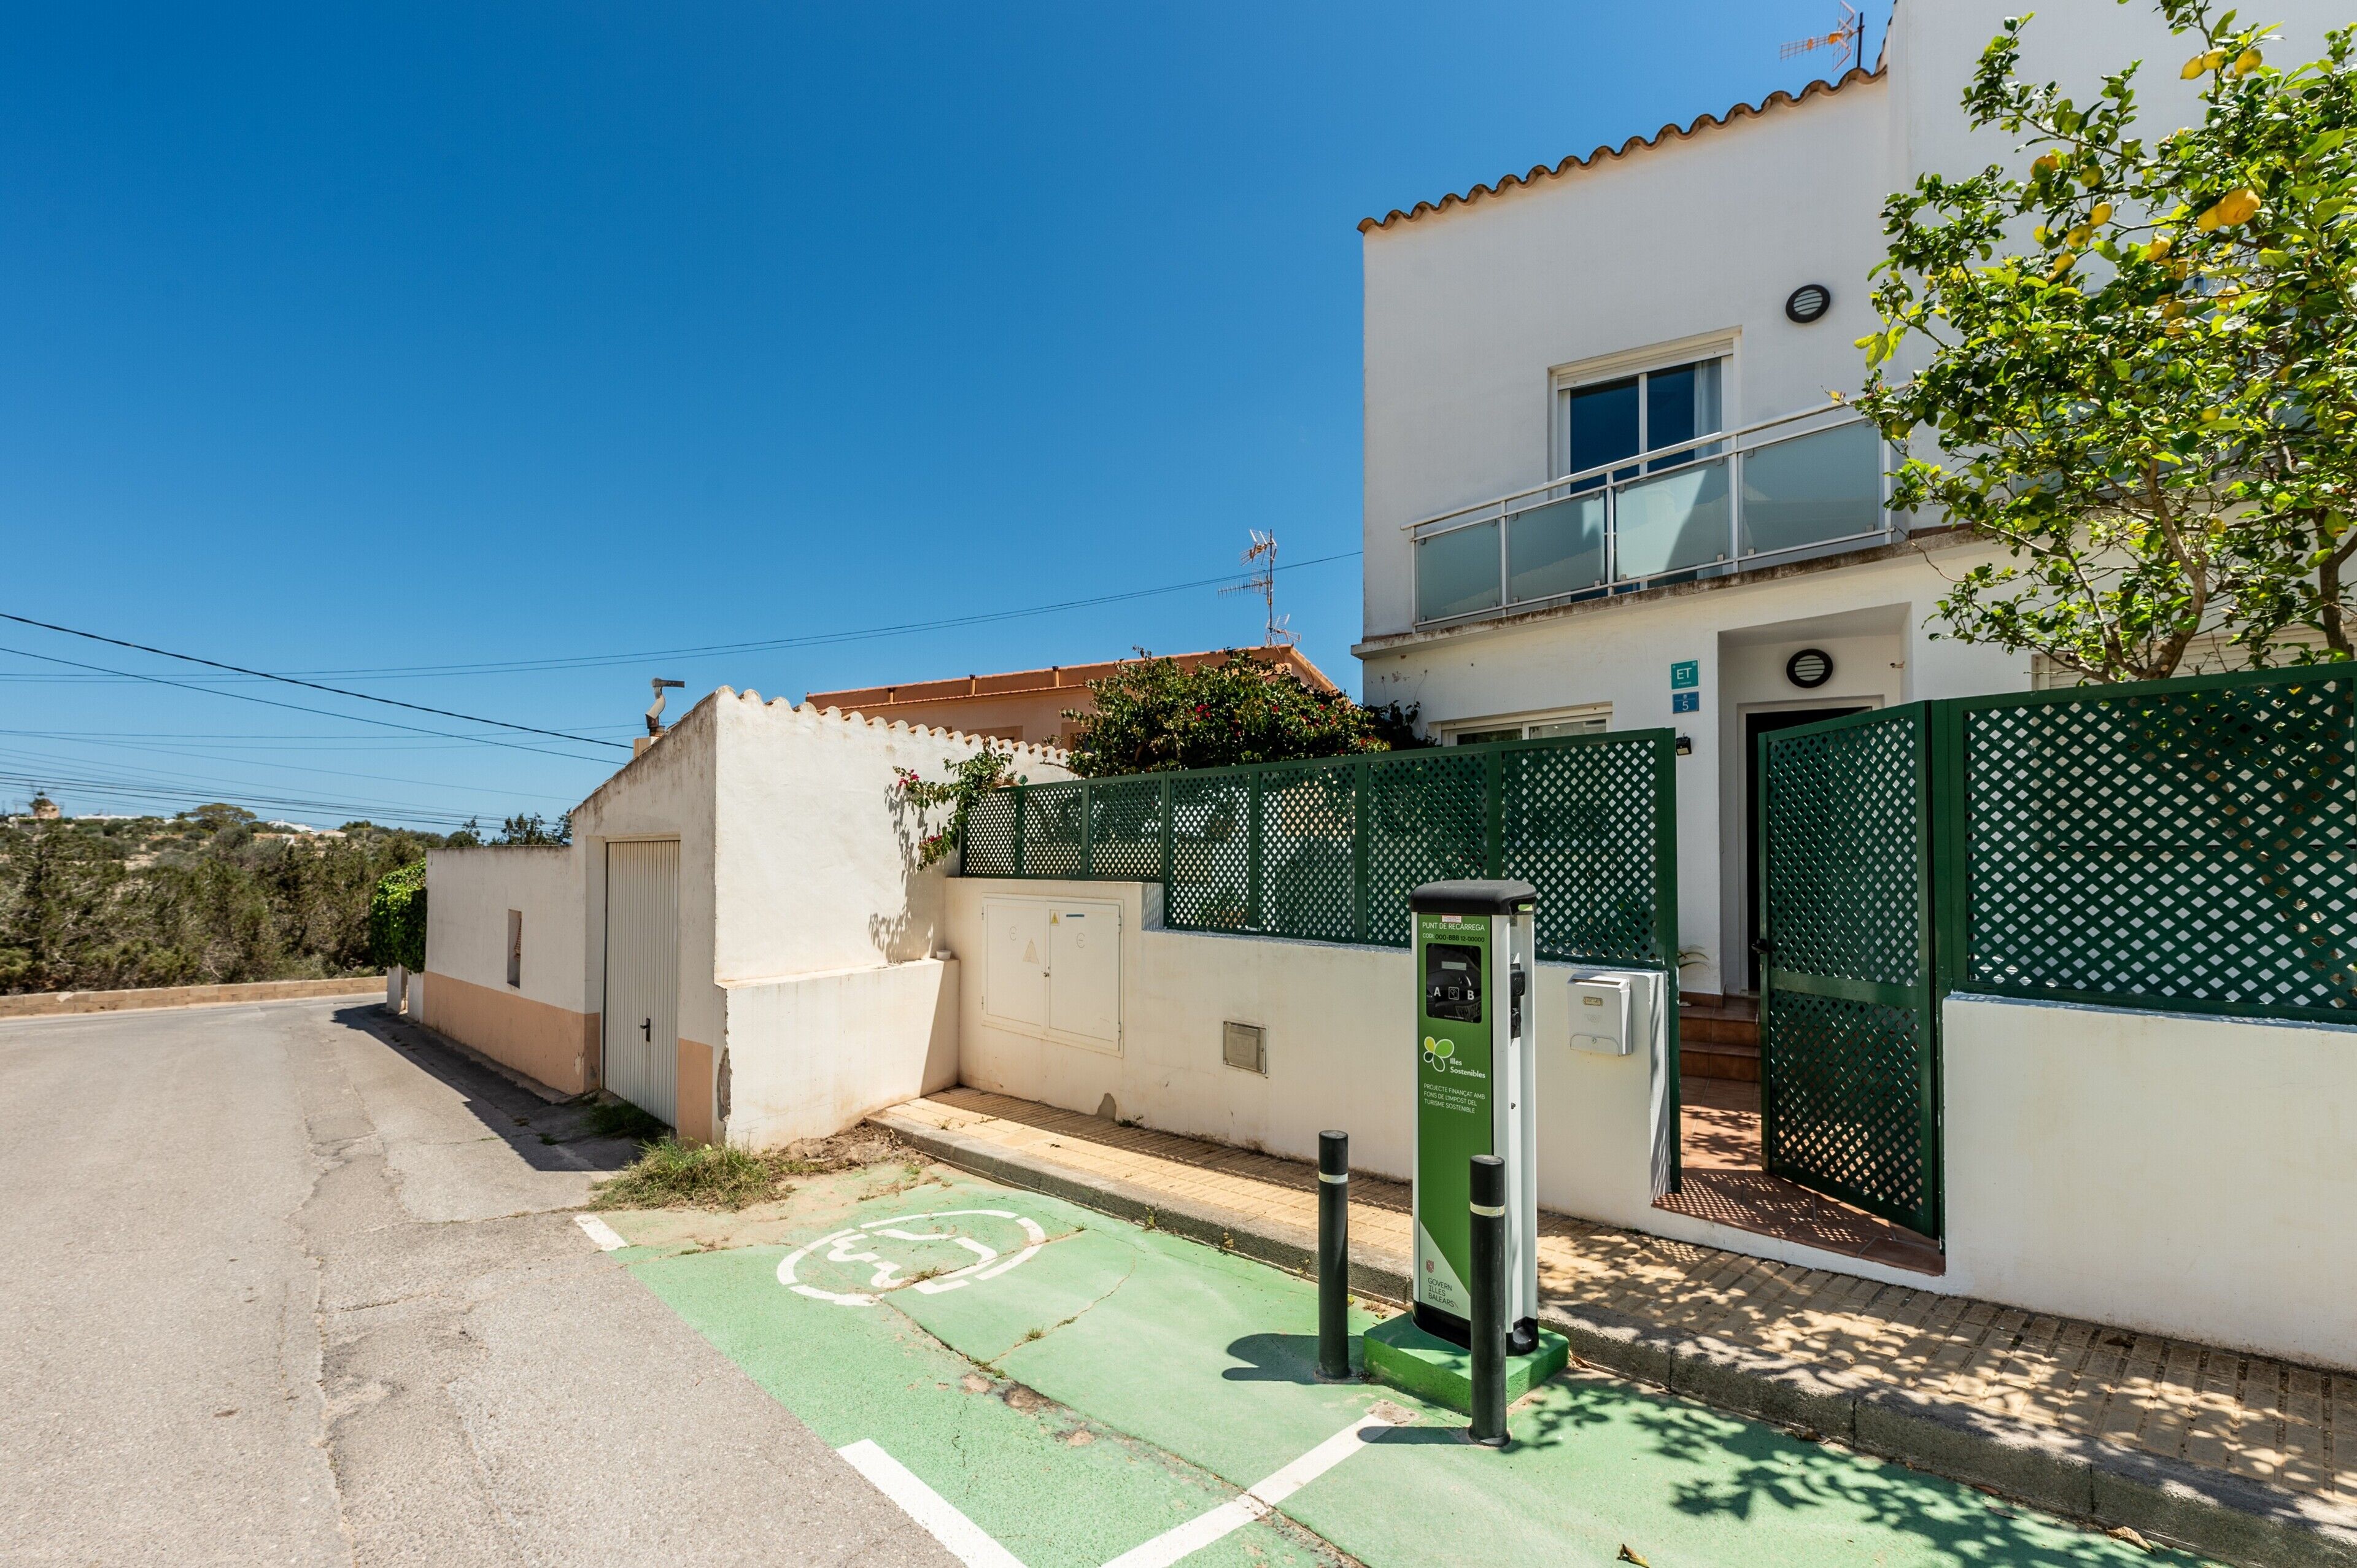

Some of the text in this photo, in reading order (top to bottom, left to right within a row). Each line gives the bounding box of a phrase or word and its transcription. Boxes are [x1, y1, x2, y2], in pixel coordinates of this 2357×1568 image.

[1677, 668, 1692, 680] ET
[1682, 701, 1689, 711] 5
[1449, 922, 1485, 931] RECÀRREGA
[1434, 987, 1441, 997] A
[1467, 990, 1474, 1000] B
[1450, 1066, 1486, 1079] Sostenibles
[1424, 1083, 1448, 1092] PROJECTE
[1449, 1087, 1473, 1098] FINANÇAT
[1445, 1095, 1467, 1104] L'IMPOST
[1424, 1098, 1476, 1114] TURISME SOSTENIBLE
[1428, 1277, 1452, 1291] GOVERN
[1428, 1284, 1446, 1296] ILLES
[1428, 1292, 1454, 1307] BALEARS
